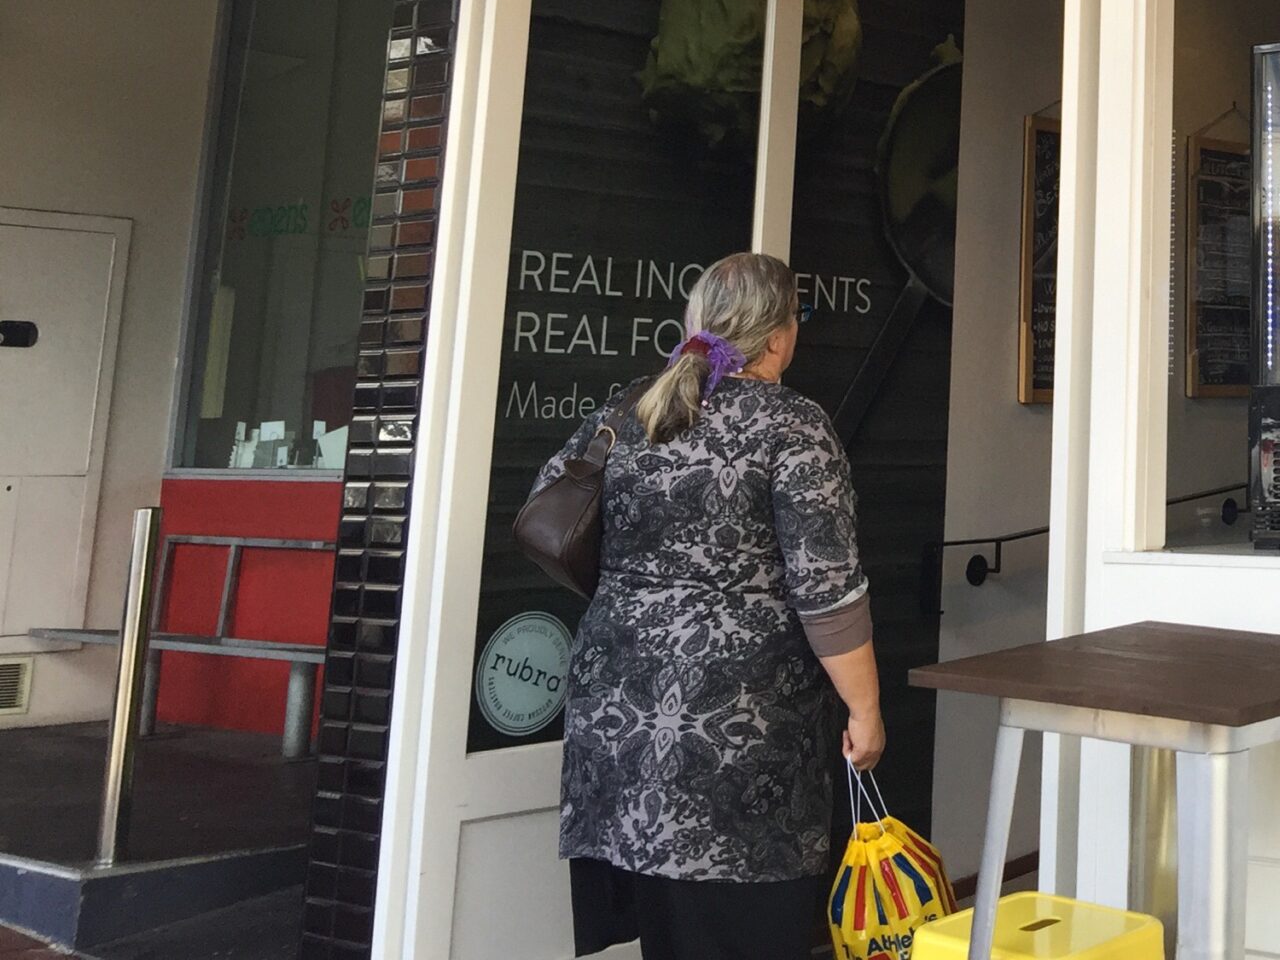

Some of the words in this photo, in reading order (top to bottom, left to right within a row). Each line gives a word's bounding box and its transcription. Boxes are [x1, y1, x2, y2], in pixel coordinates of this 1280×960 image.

[519, 249, 623, 296] REAL
[635, 259, 871, 314] INGENTS
[513, 311, 619, 356] REAL
[631, 317, 685, 358] FO
[505, 380, 595, 419] Made
[516, 624, 554, 640] PROUDLY
[490, 652, 561, 693] rubra
[502, 708, 526, 722] COFFEE
